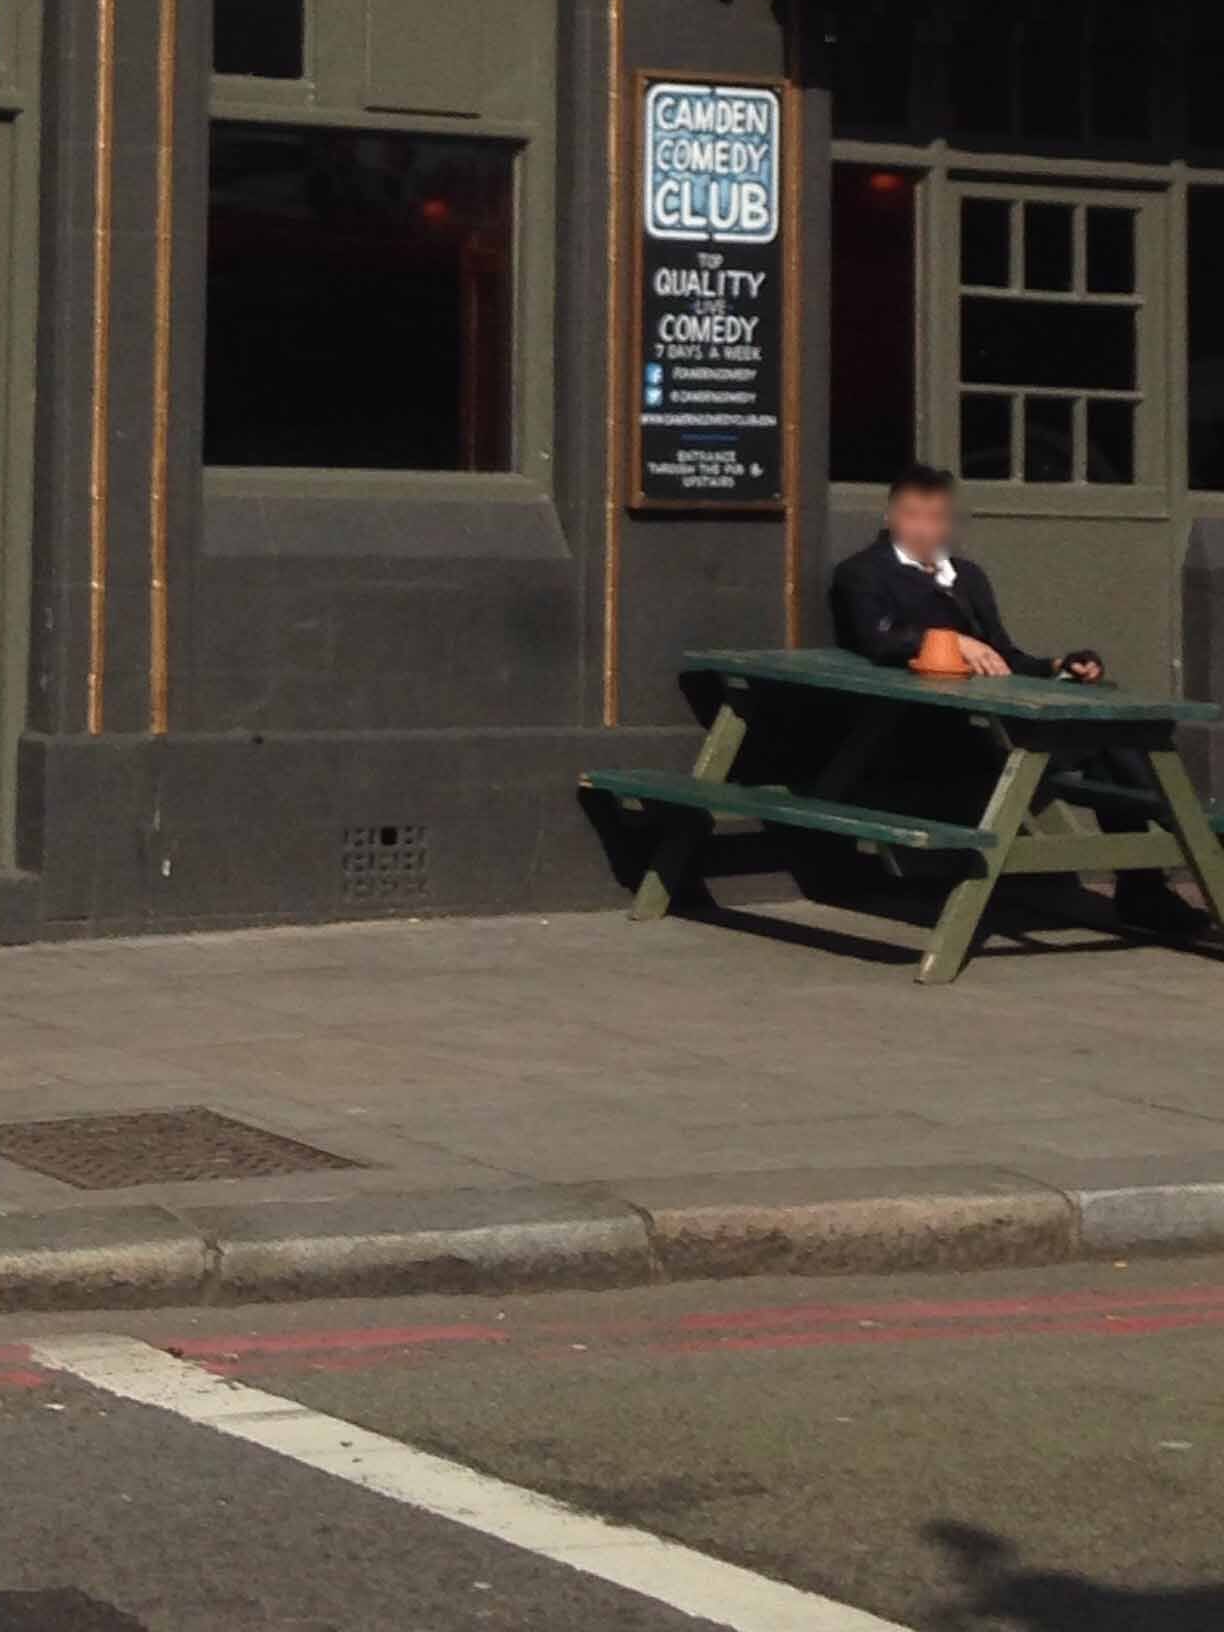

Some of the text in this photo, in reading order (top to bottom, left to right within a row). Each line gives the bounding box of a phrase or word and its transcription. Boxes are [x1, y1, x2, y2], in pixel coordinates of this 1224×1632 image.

[656, 95, 769, 135] CAMDEN
[657, 138, 769, 174] COMEDY
[655, 179, 770, 229] CLUB
[654, 266, 766, 299] QUALITY
[659, 313, 759, 343] COMEDY
